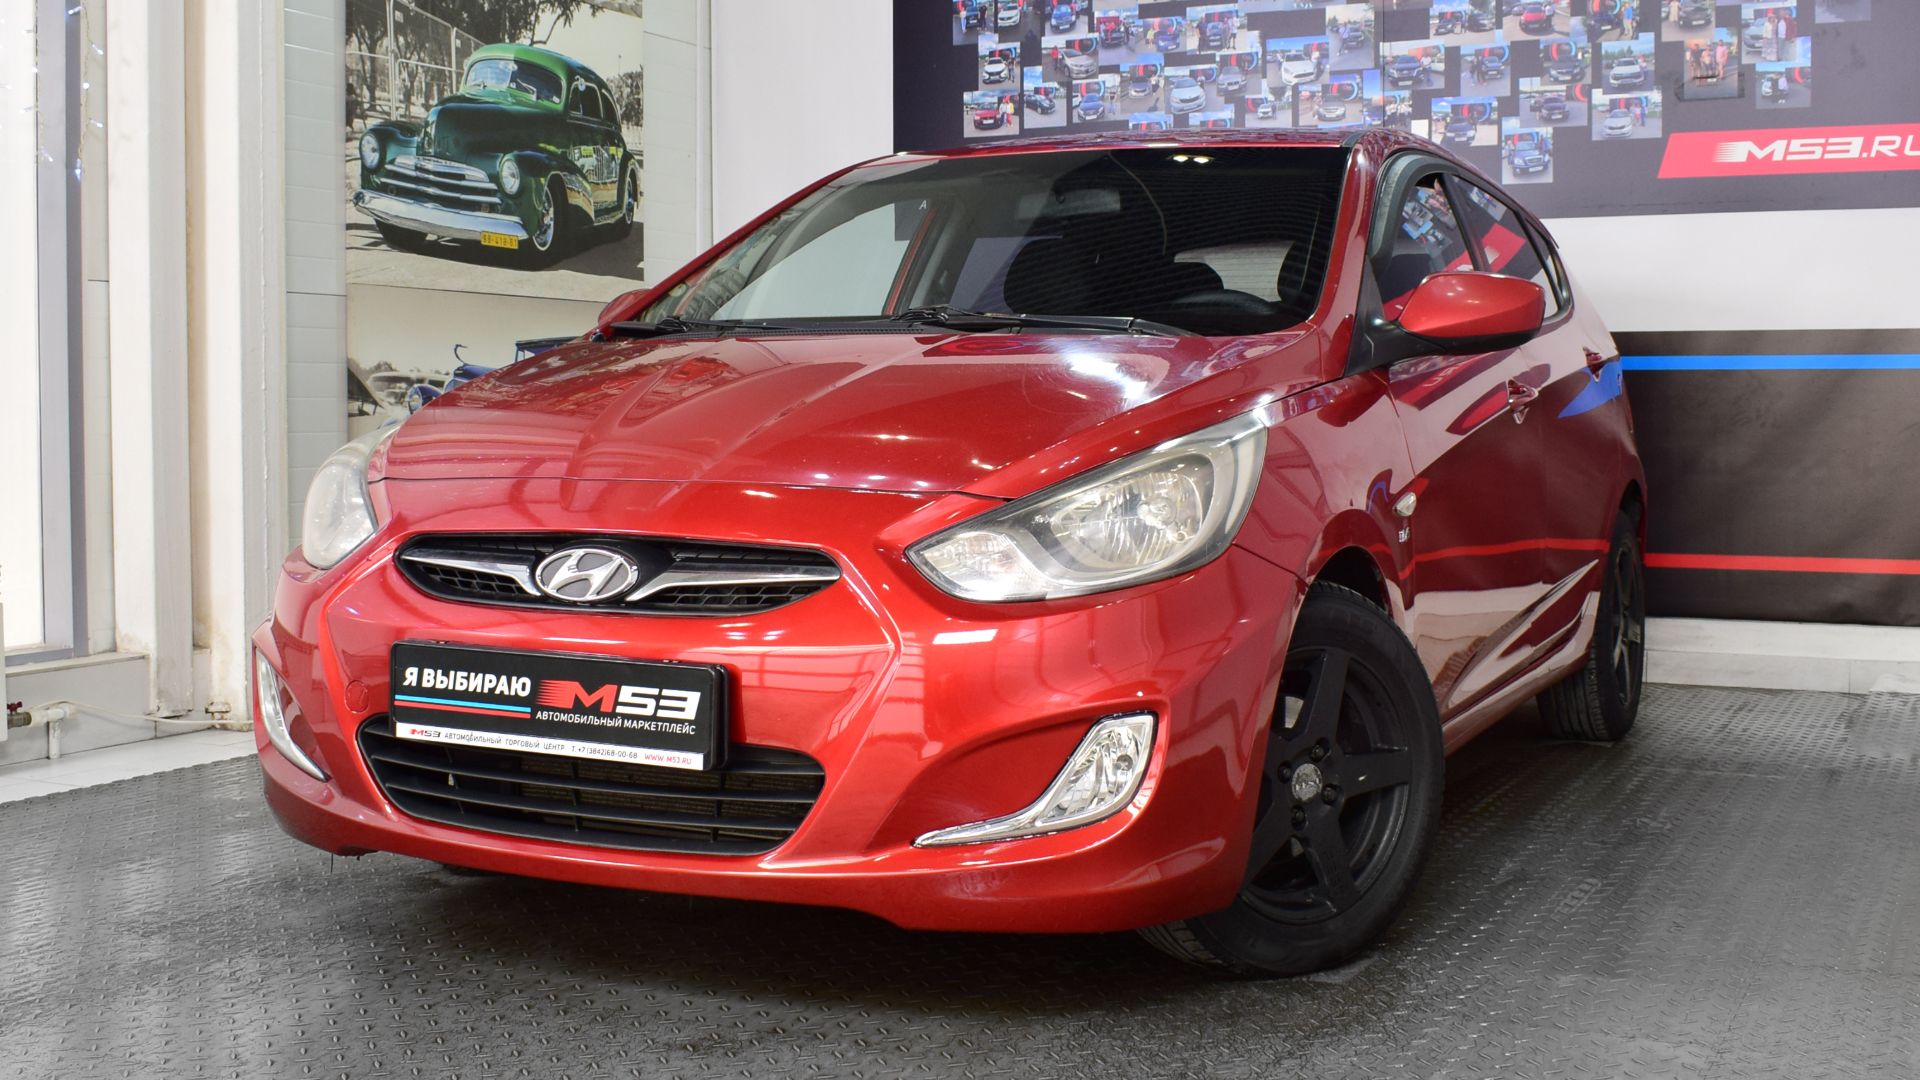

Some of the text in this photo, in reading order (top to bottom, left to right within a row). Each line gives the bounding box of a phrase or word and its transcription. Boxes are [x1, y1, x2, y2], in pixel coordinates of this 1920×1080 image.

[403, 667, 532, 697] Я ВЫБИРАЮ
[537, 679, 702, 720] M53
[535, 710, 696, 735] АВТОМОБИЛЬНЫЙ МАРКЕТПЛЕЙС
[444, 731, 502, 744] АВТОМОБИЛЬНЫЙ
[505, 738, 540, 749] ТОРГОВЫЙ
[543, 742, 565, 751] ЦЕНТР
